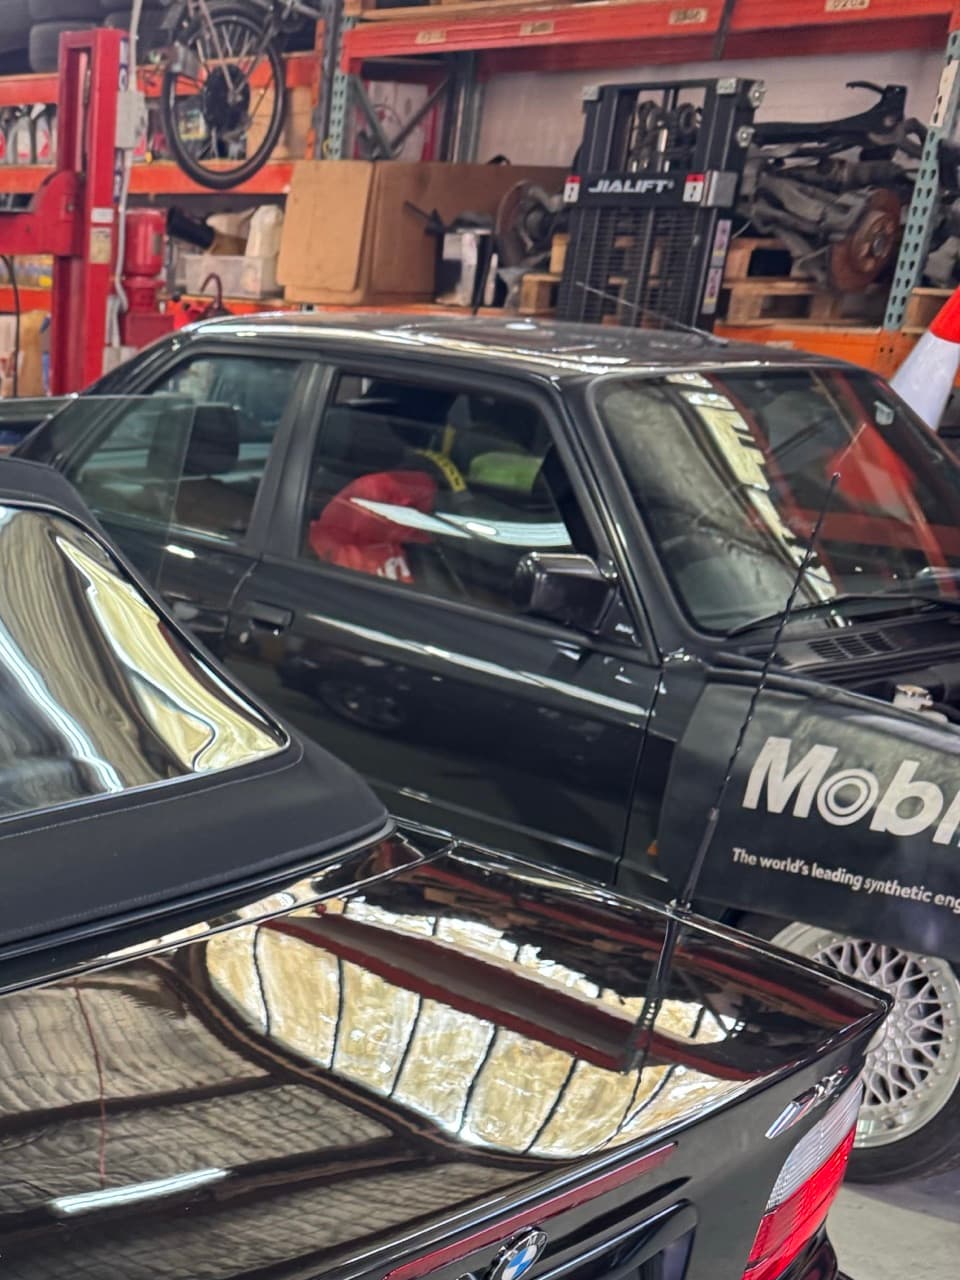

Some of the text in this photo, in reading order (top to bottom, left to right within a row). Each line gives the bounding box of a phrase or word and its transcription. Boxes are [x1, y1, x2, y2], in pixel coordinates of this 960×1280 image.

[588, 179, 668, 193] JIALIFT
[732, 847, 757, 865] The
[811, 862, 863, 891] leading
[863, 878, 933, 903] synthetic
